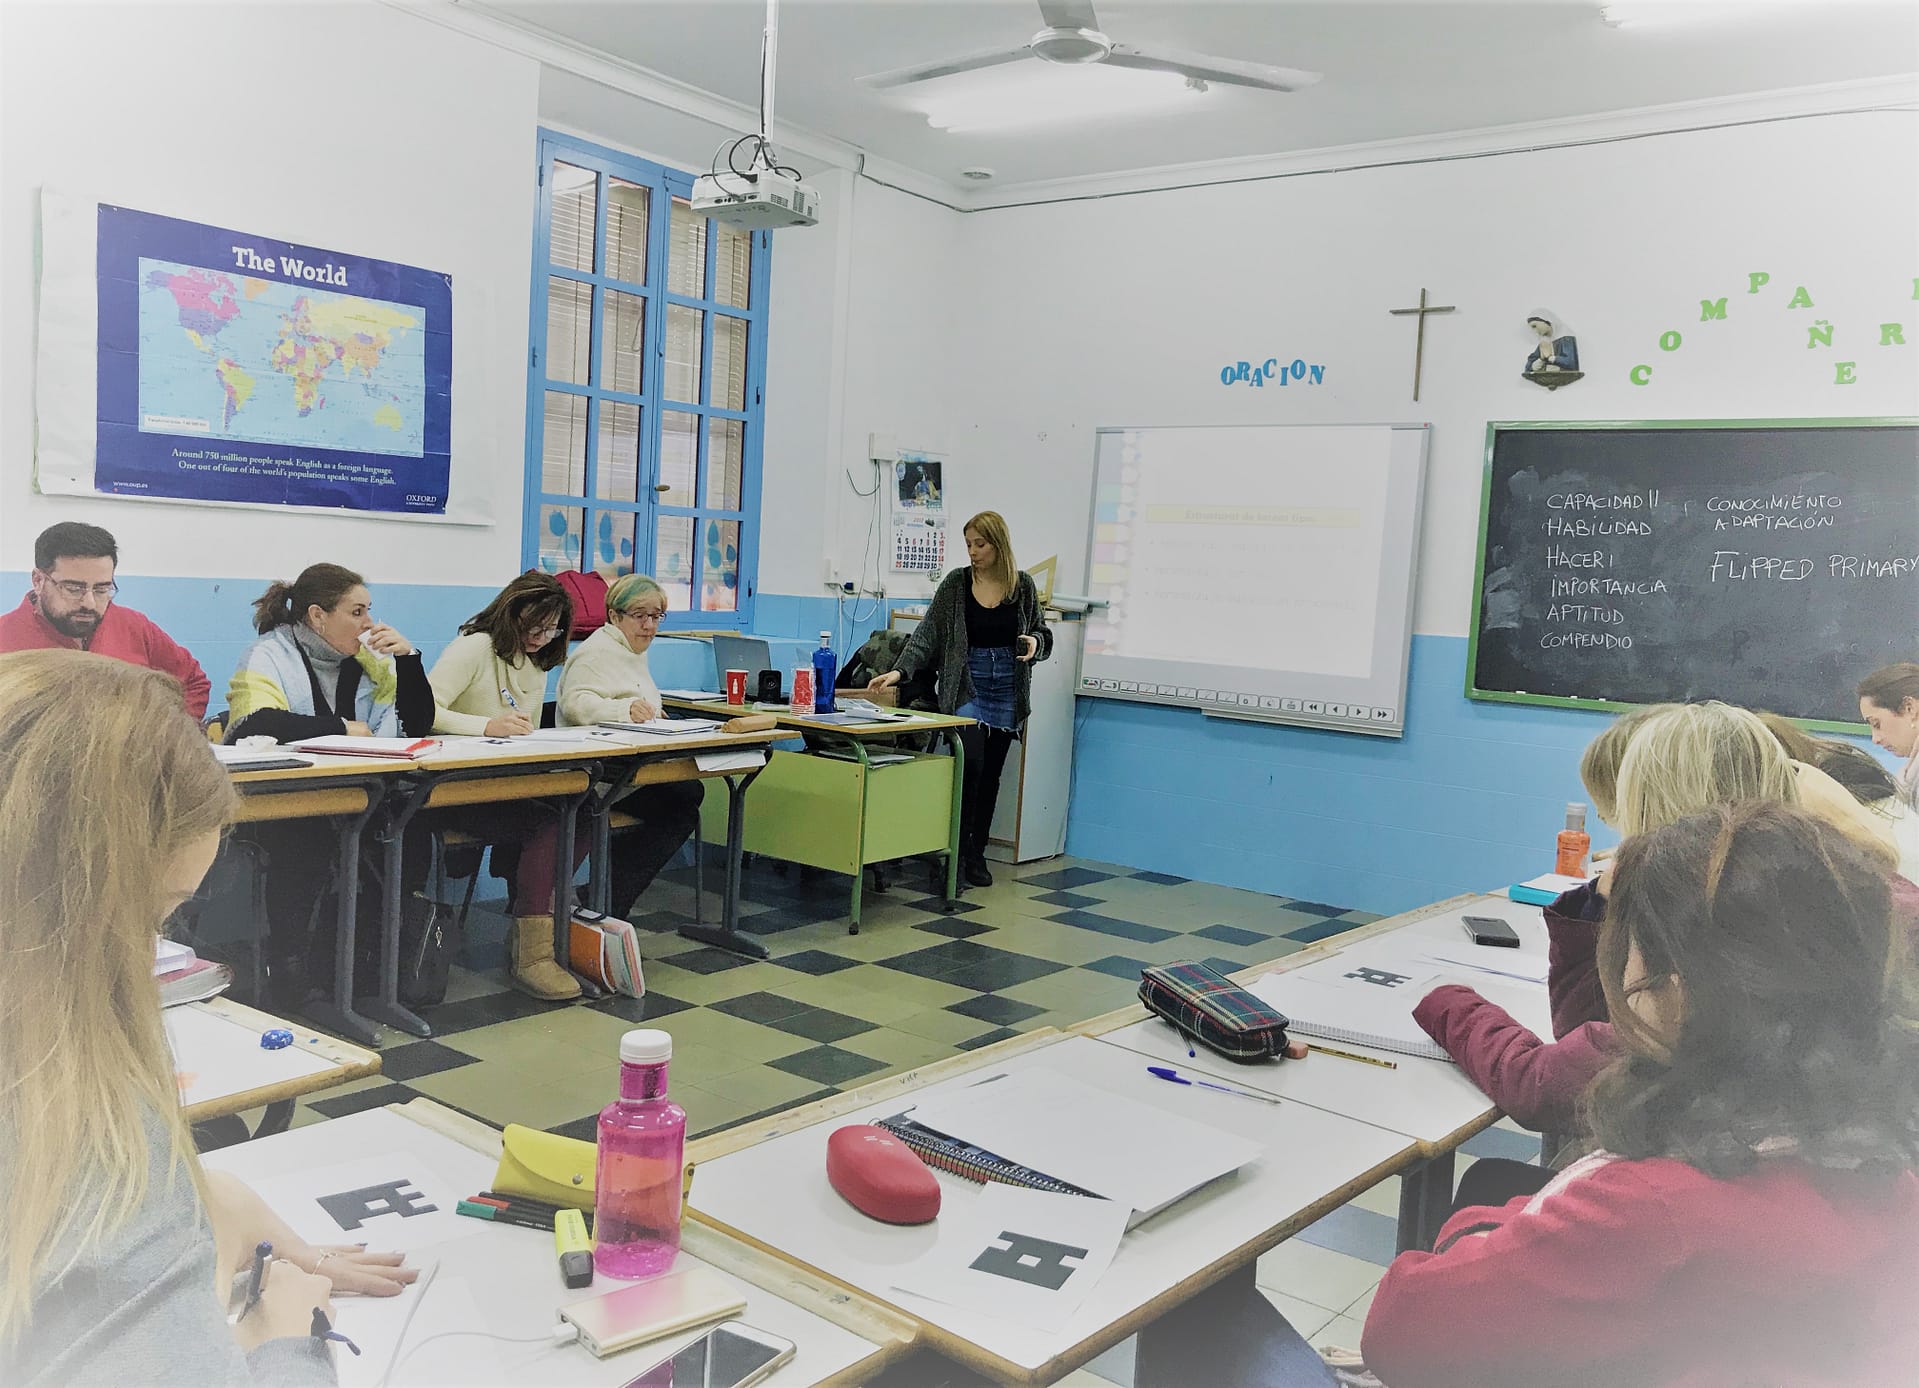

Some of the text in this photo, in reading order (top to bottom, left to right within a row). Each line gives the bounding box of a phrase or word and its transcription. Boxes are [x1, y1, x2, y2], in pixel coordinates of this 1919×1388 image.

[232, 246, 348, 287] The World
[1220, 358, 1326, 387] ORACION
[171, 448, 203, 459] Around
[205, 451, 219, 460] 750
[221, 453, 247, 462] million
[249, 456, 274, 466] people
[275, 457, 294, 467] speak
[296, 458, 322, 470] English
[337, 462, 361, 473] foreign
[178, 460, 396, 486] One out of four of the world's population speaks some English.
[406, 494, 437, 503] OXFORD
[1546, 493, 1643, 511] CAPACIDAD
[1706, 494, 1842, 512] CONOCIMIENTO
[1543, 515, 1652, 538] HABILIDAD
[1546, 544, 1604, 569] HACER
[1711, 550, 1814, 582] FLIPPED
[1551, 574, 1668, 598] IMPORTANCIA
[1547, 603, 1624, 625] APTITUD
[1540, 632, 1632, 650] COMPENDIO
